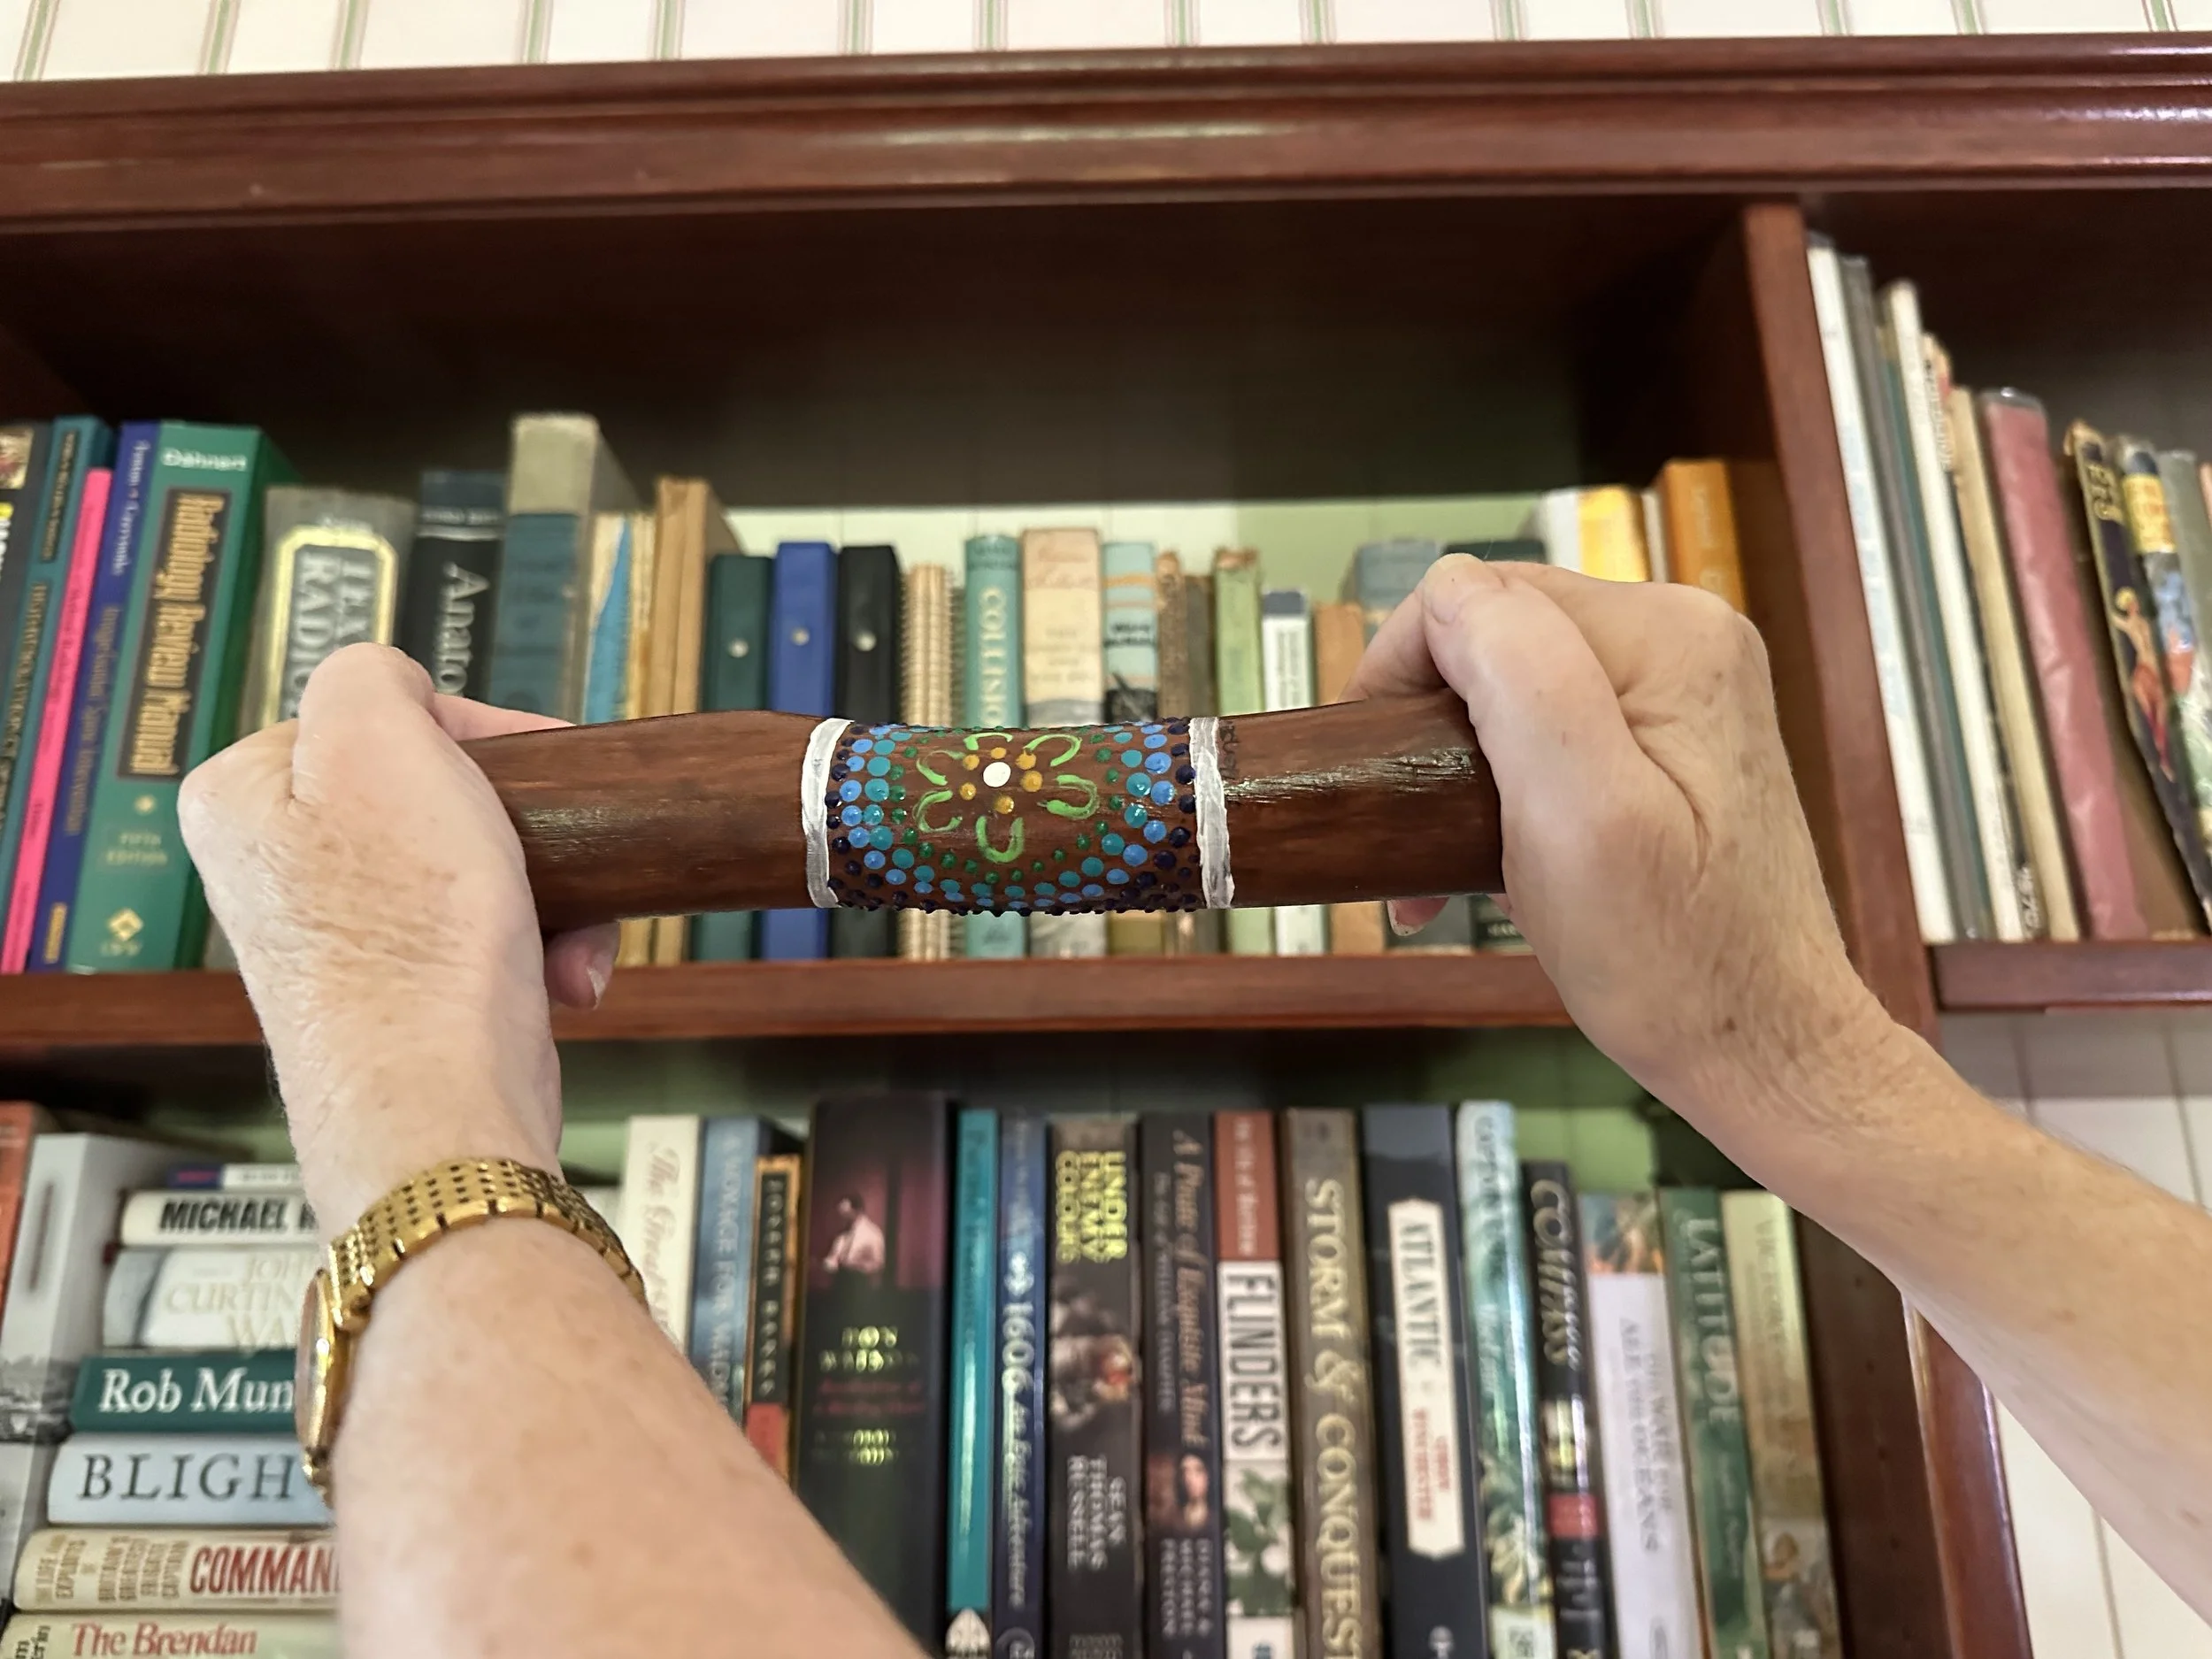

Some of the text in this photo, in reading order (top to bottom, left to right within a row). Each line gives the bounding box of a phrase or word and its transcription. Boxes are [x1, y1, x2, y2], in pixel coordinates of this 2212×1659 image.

[128, 493, 225, 776] Radiology Review Manual
[284, 554, 342, 713] RADIO
[439, 561, 490, 695] Anato
[978, 585, 1008, 727] COLLISIO
[159, 1199, 287, 1231] MICHAEL
[1080, 1152, 1106, 1263] ENEMY
[1104, 1151, 1127, 1259] UNDER
[1305, 1178, 1352, 1338] STORM
[247, 1253, 314, 1283] JOH
[1399, 1223, 1440, 1365] ATLANTIC
[1531, 1179, 1579, 1371] COMPASS
[99, 1366, 296, 1413] Rob Mun
[1226, 1274, 1281, 1448] FLINDERS
[1304, 1348, 1365, 1407] &
[78, 1453, 296, 1502] BLIGH
[188, 1544, 342, 1594] COMMAN
[73, 1622, 127, 1657] The
[132, 1621, 257, 1657] Brendan
